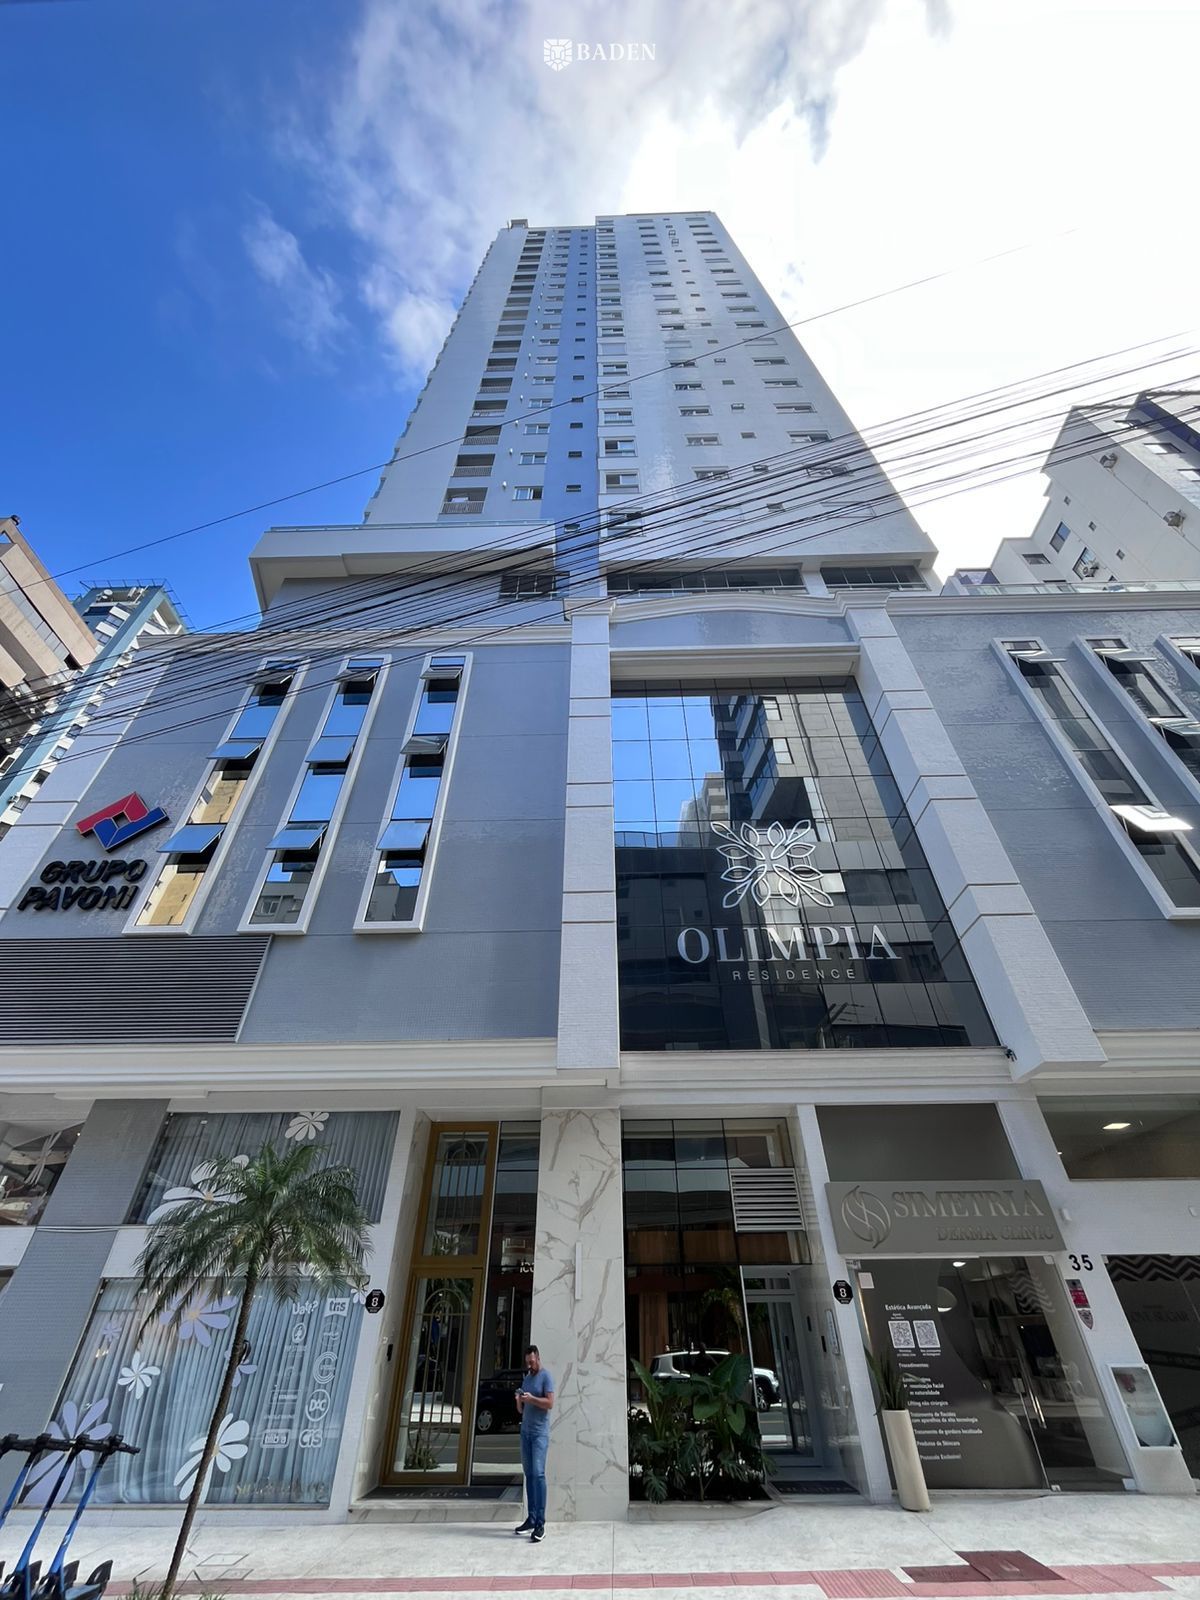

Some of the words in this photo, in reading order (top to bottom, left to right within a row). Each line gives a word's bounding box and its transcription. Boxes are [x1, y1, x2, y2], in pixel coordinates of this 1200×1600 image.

[40, 859, 148, 884] GRUPO
[17, 885, 139, 911] PAVONI
[677, 924, 902, 964] OLIMPIA
[732, 968, 856, 981] RESIDENCE
[892, 1189, 1045, 1219] SIMETRIA
[936, 1226, 997, 1241] DERMA
[1000, 1225, 1054, 1241] CLINIC
[1068, 1254, 1094, 1272] 35
[839, 1287, 847, 1298] 8
[328, 1300, 346, 1312] tris
[371, 1296, 379, 1307] 8
[907, 1303, 932, 1311] Avançada
